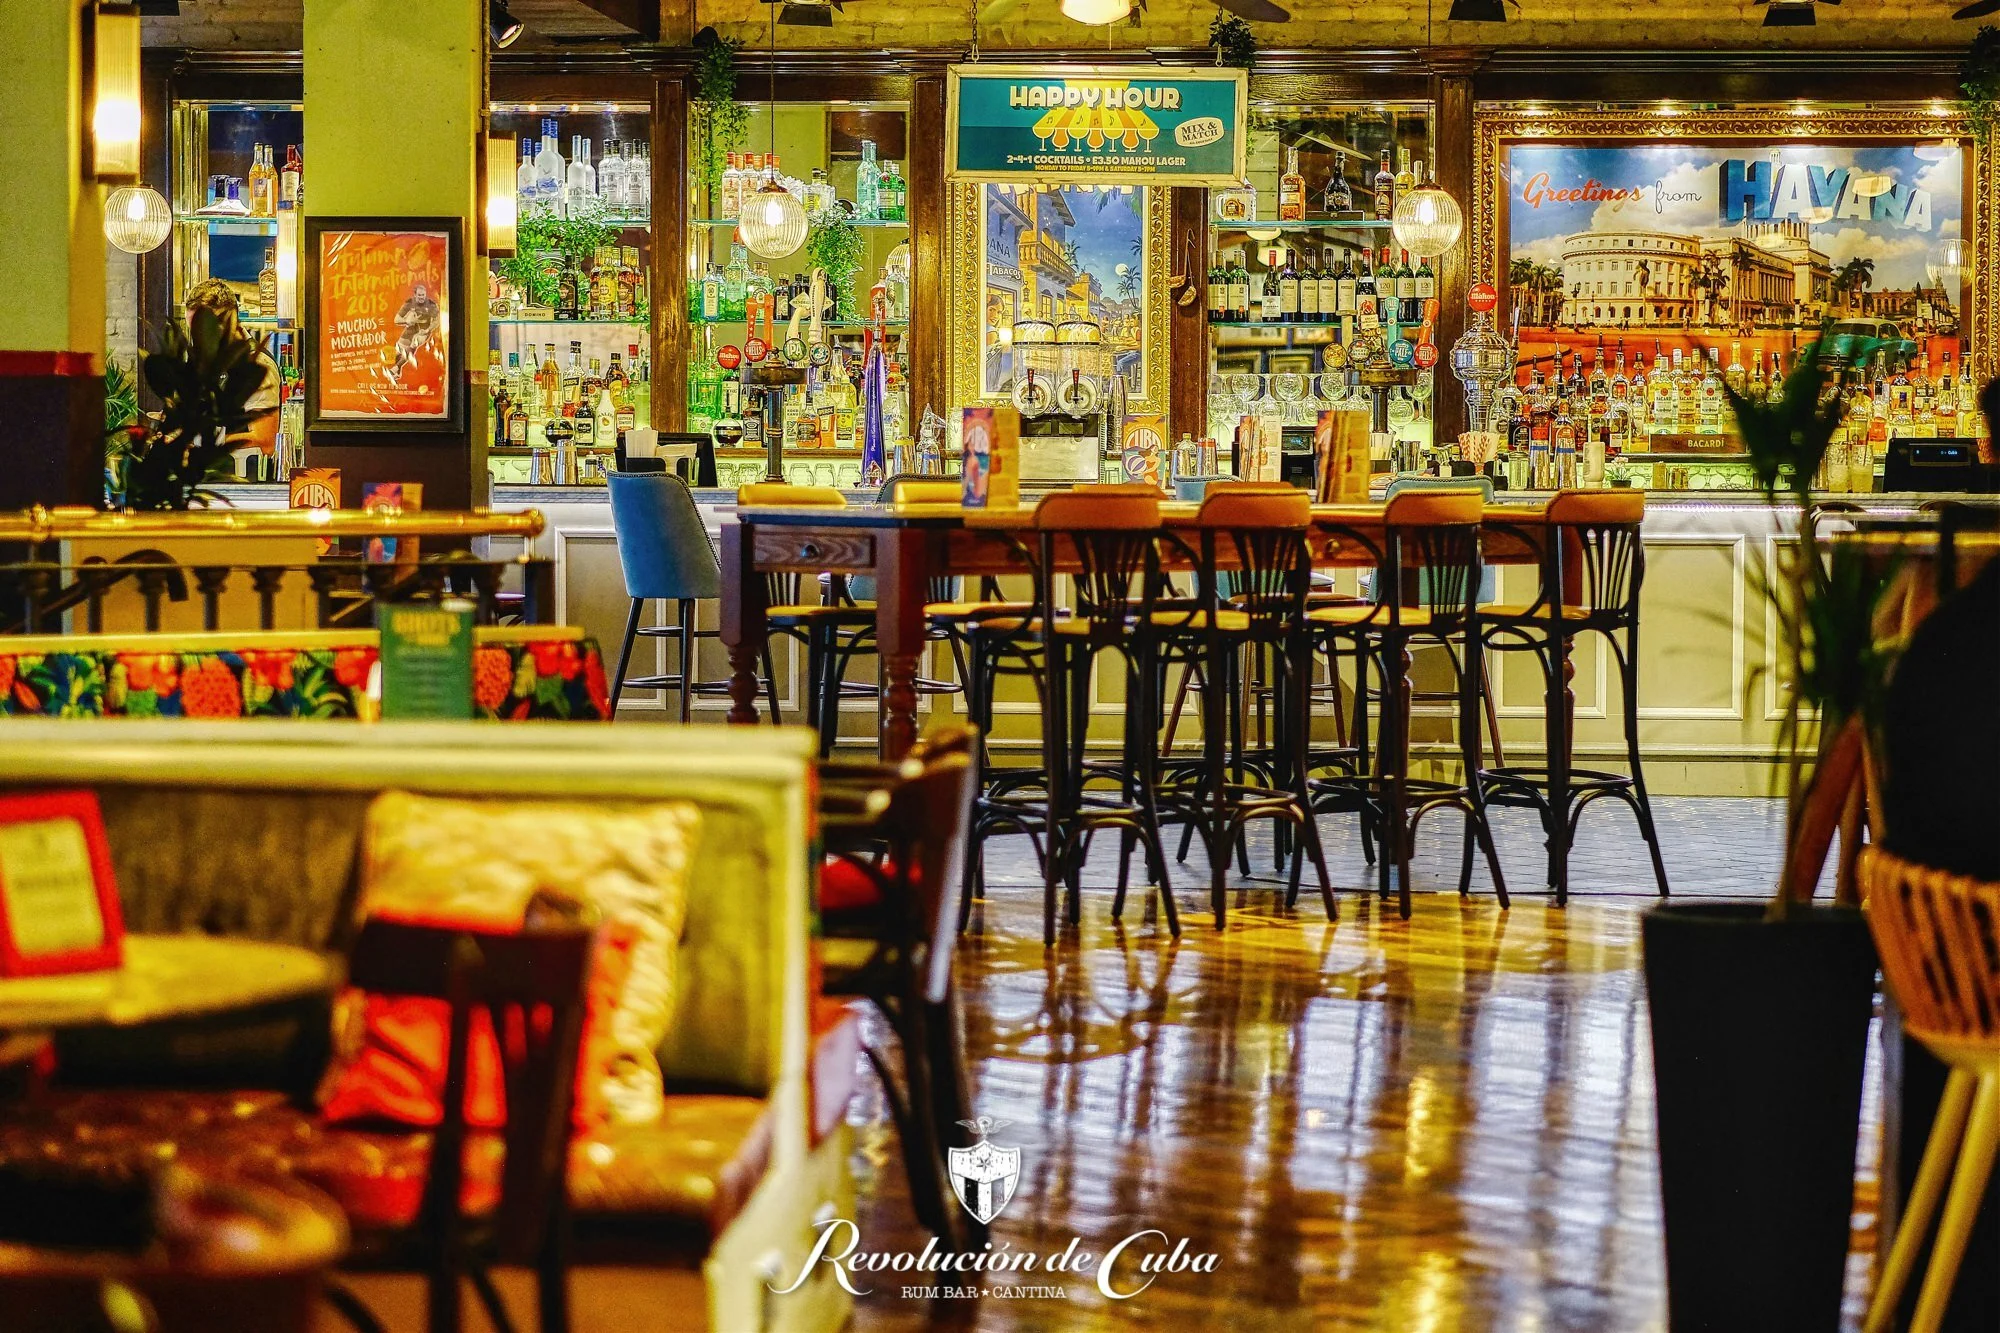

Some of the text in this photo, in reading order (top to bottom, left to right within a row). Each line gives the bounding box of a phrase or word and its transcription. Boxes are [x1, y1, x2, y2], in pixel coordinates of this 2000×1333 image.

[1009, 85, 1181, 110] HAPPY HOUR
[1181, 121, 1217, 135] MIX &
[1182, 129, 1218, 142] MATCH
[1006, 154, 1186, 166] 2-4-1 COCKTAILS £3.50 MAHOU LAGER
[1522, 159, 1932, 232] Greetings from HAVANA
[330, 260, 439, 300] Internationals
[988, 264, 1021, 280] TABACOS
[347, 293, 389, 316] 2018
[337, 317, 378, 335] MUCHOS
[331, 331, 388, 351] MOSTRADOR
[787, 343, 802, 356] IPA
[1125, 428, 1162, 450] CUBA
[1687, 437, 1725, 448] BACARDÍ
[293, 484, 335, 510] CUBA
